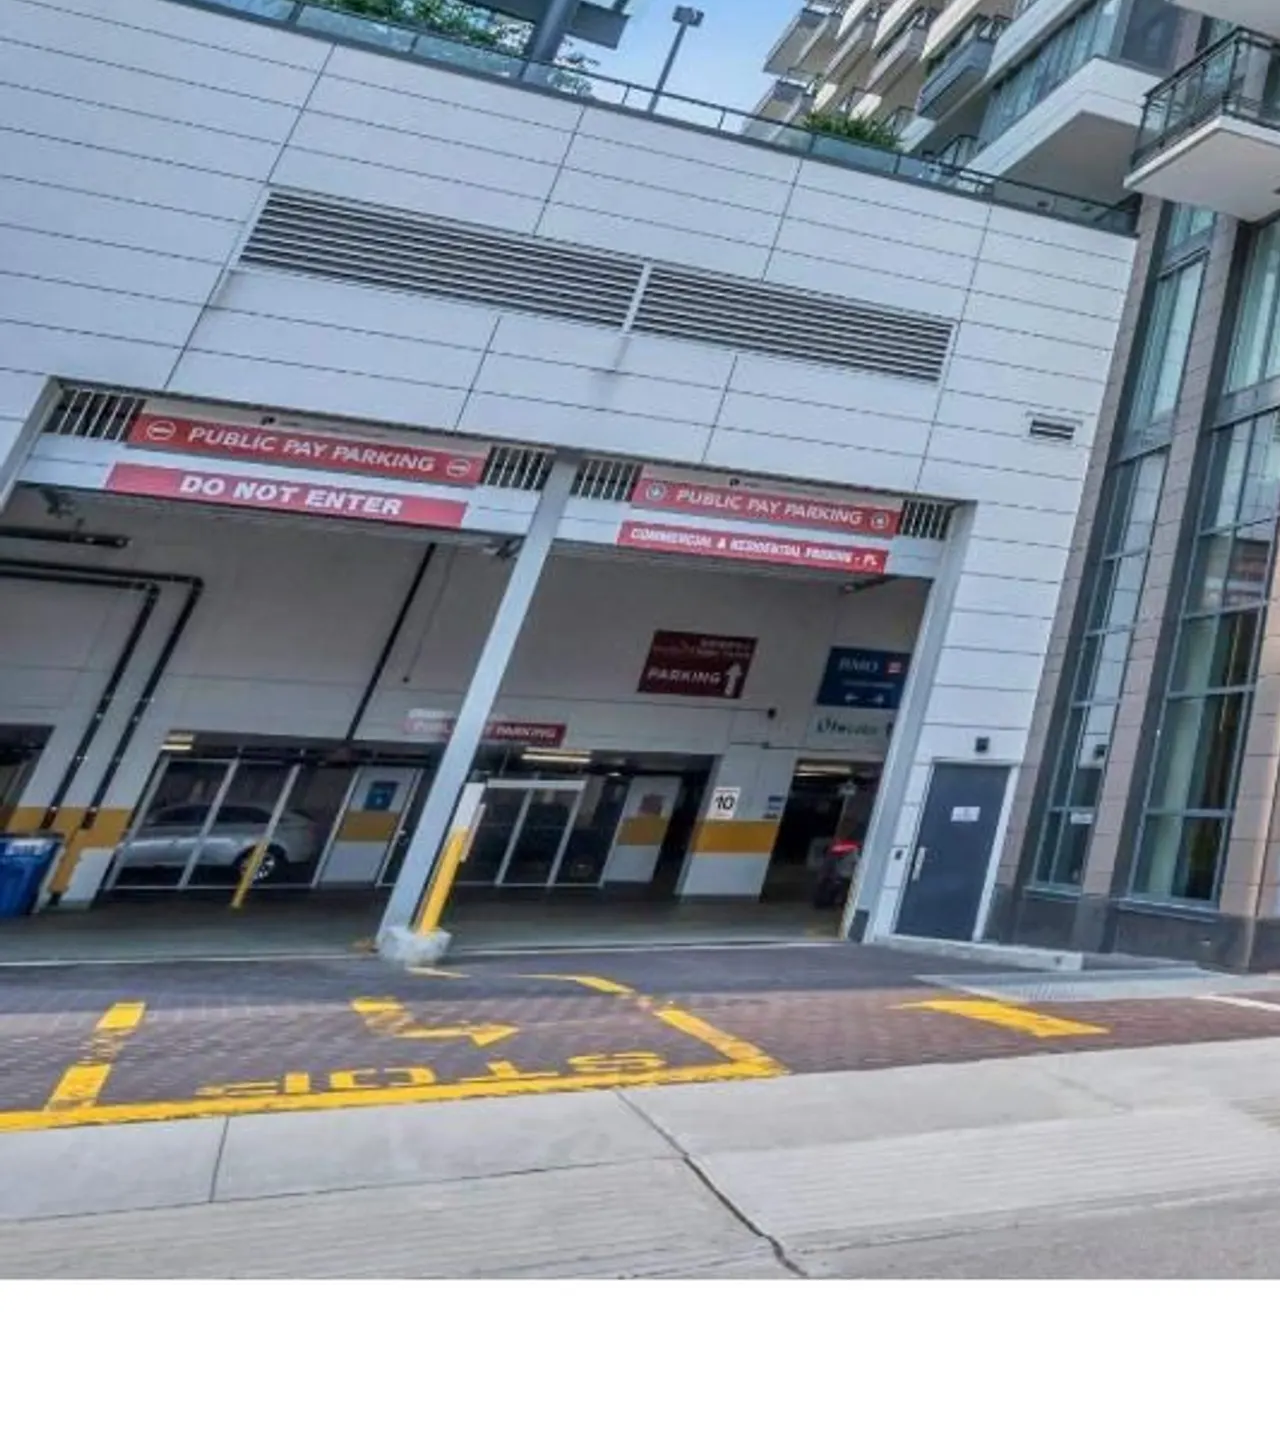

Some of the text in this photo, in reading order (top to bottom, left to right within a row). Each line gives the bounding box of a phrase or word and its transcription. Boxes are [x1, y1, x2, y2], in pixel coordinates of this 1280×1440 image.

[187, 426, 275, 452] PUBLIC
[282, 440, 328, 458] PAY
[332, 446, 436, 472] PARKING
[180, 474, 403, 515] DO NOT ENTER
[676, 489, 864, 526] PUBLIC PAY PARKING
[647, 667, 721, 685] PARKING
[715, 794, 736, 811] 10
[195, 1050, 667, 1097] STOP
